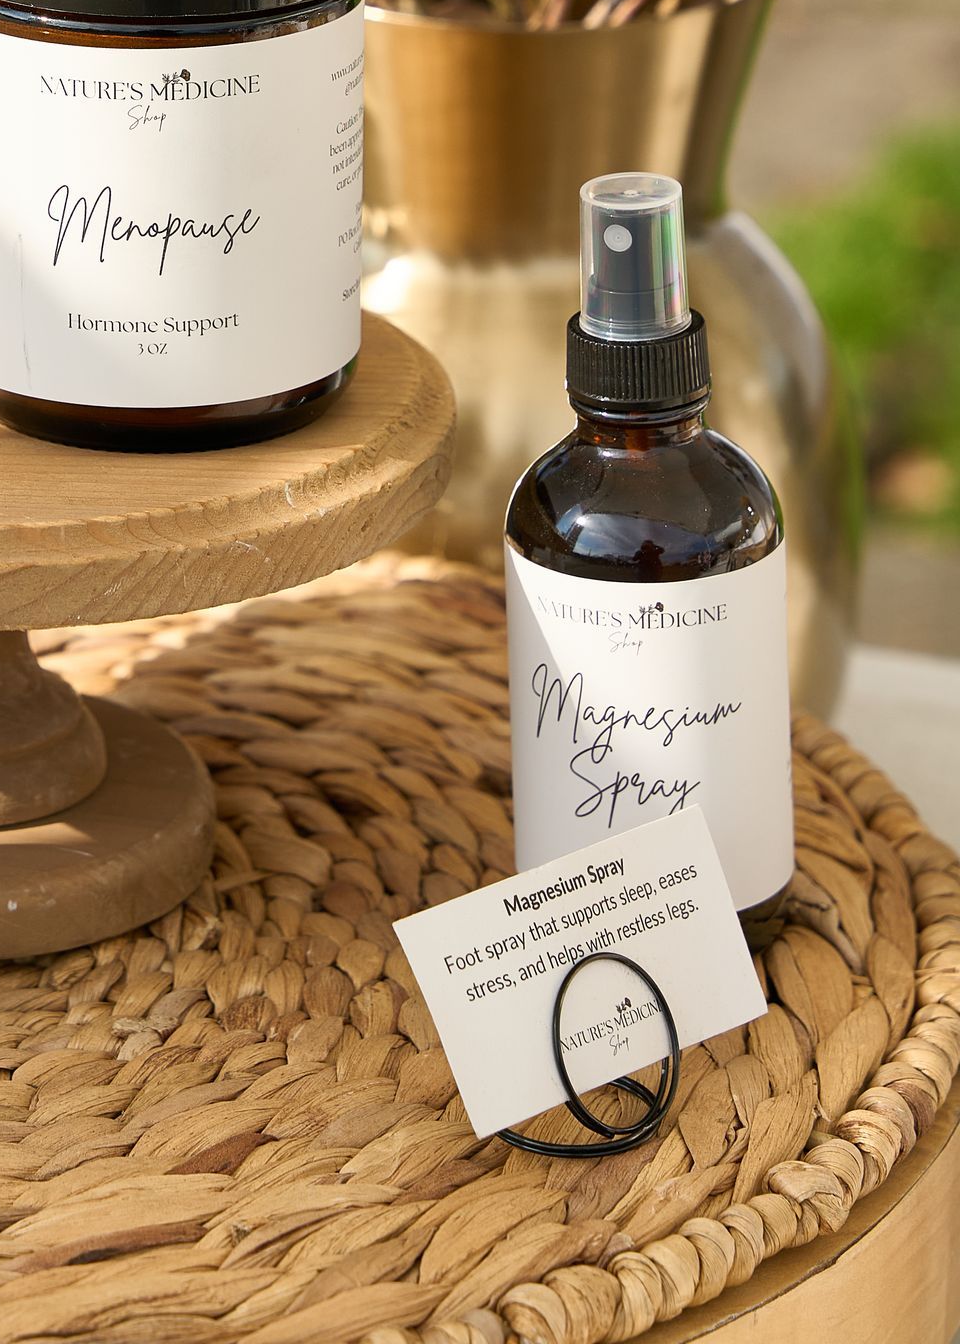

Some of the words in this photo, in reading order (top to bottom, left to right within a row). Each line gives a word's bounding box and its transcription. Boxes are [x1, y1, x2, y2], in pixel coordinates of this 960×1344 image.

[40, 74, 144, 101] NATURE'S
[150, 73, 261, 102] MEDICINE
[127, 105, 167, 132] Shop
[47, 184, 261, 276] Menopause
[68, 313, 158, 334] Hormone
[163, 312, 240, 337] Support
[138, 342, 144, 356] 3
[147, 342, 168, 356] OZ
[537, 596, 623, 628] NATURE'S
[628, 603, 728, 629] MEDICINE
[608, 631, 644, 656] Shop
[531, 663, 742, 764] Magnesium
[502, 870, 588, 917] Magnesium
[587, 857, 626, 885] Spray
[443, 946, 483, 975] Foot
[484, 934, 527, 961] spray
[528, 919, 560, 943] that
[560, 896, 619, 932] supports
[618, 880, 658, 910] sleep,
[657, 863, 699, 891] eases
[465, 972, 518, 1003] stress,
[519, 955, 547, 982] and
[546, 942, 586, 971] helps
[585, 927, 617, 956] with
[616, 909, 668, 941] restless
[666, 895, 700, 926] legs.
[559, 1019, 615, 1054] NATURE'S
